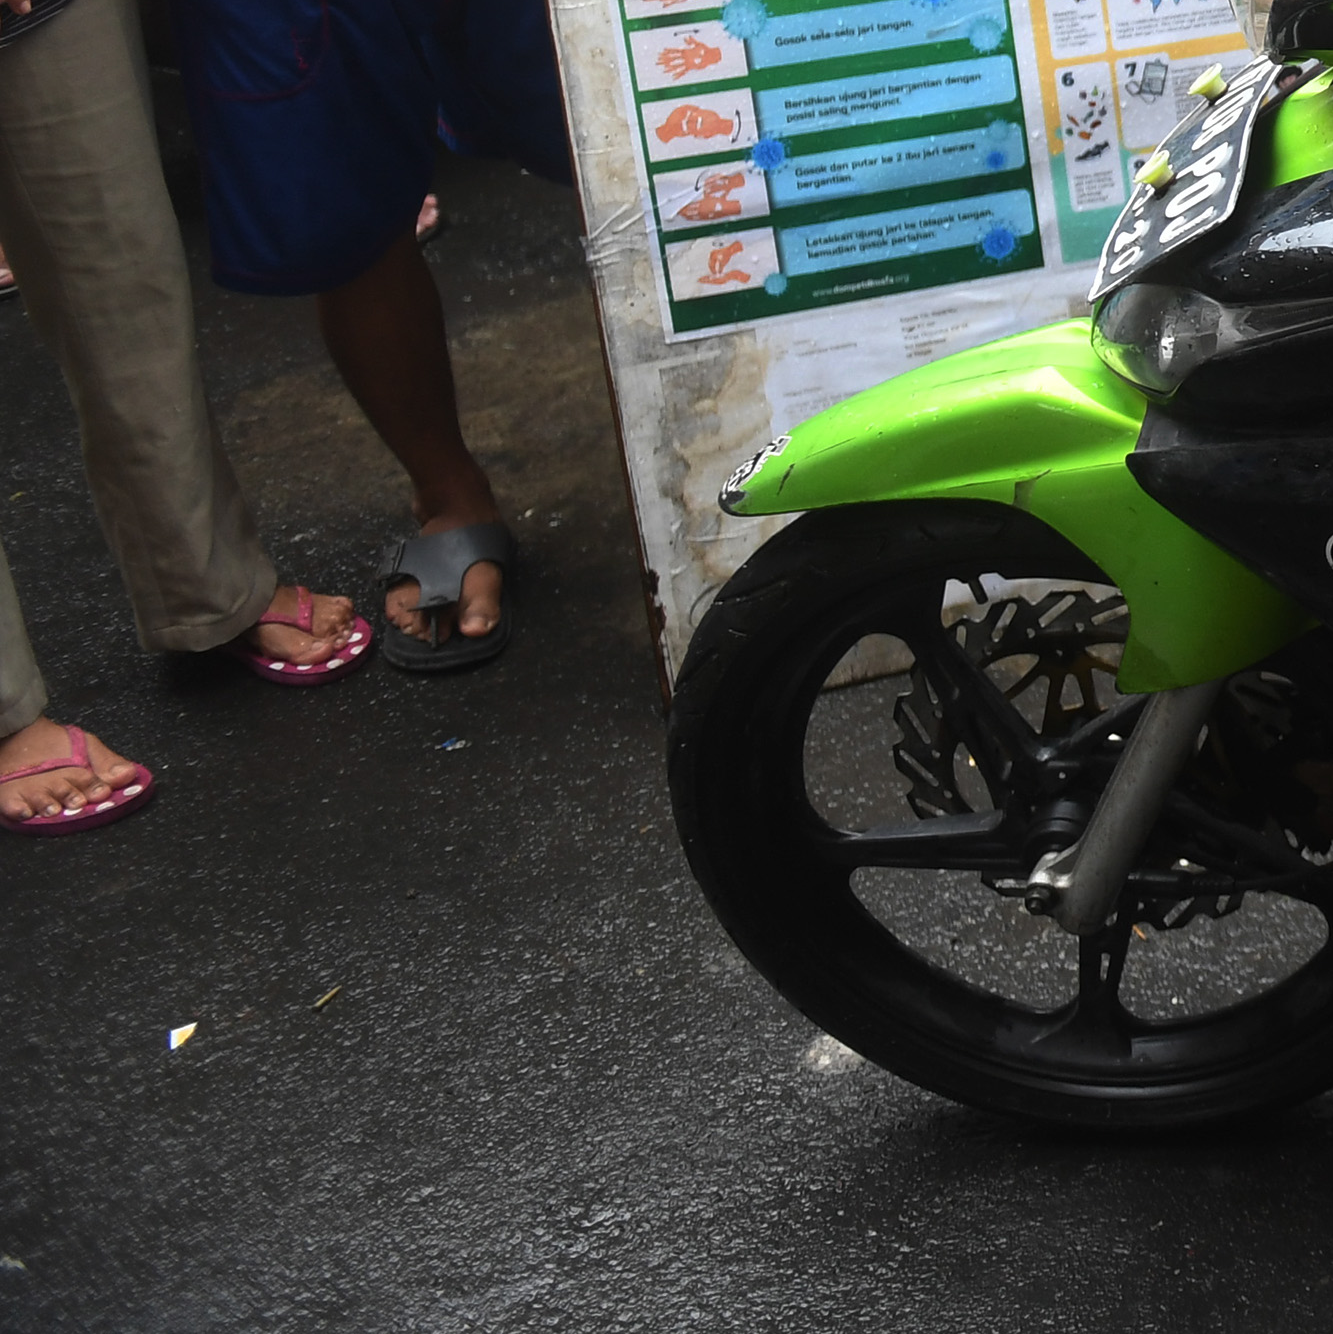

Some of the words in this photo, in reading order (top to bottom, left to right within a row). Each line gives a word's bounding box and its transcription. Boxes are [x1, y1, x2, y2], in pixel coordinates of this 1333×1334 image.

[775, 34, 806, 47] Gosok
[856, 23, 875, 39] jari
[1124, 62, 1137, 77] 7
[1061, 71, 1074, 87] 6
[784, 95, 837, 110] Bersihkan
[840, 92, 865, 106] ujung
[867, 88, 885, 102] jari
[944, 72, 982, 89] dengan
[786, 110, 814, 123] posisi
[817, 105, 847, 120] saling
[795, 166, 826, 178] Gosok
[829, 163, 849, 174] dan
[850, 158, 879, 173] putar
[882, 156, 895, 166] ke
[897, 153, 902, 163] 2
[923, 147, 940, 160] jari
[885, 222, 902, 237] jari
[807, 243, 856, 260] kemudian
